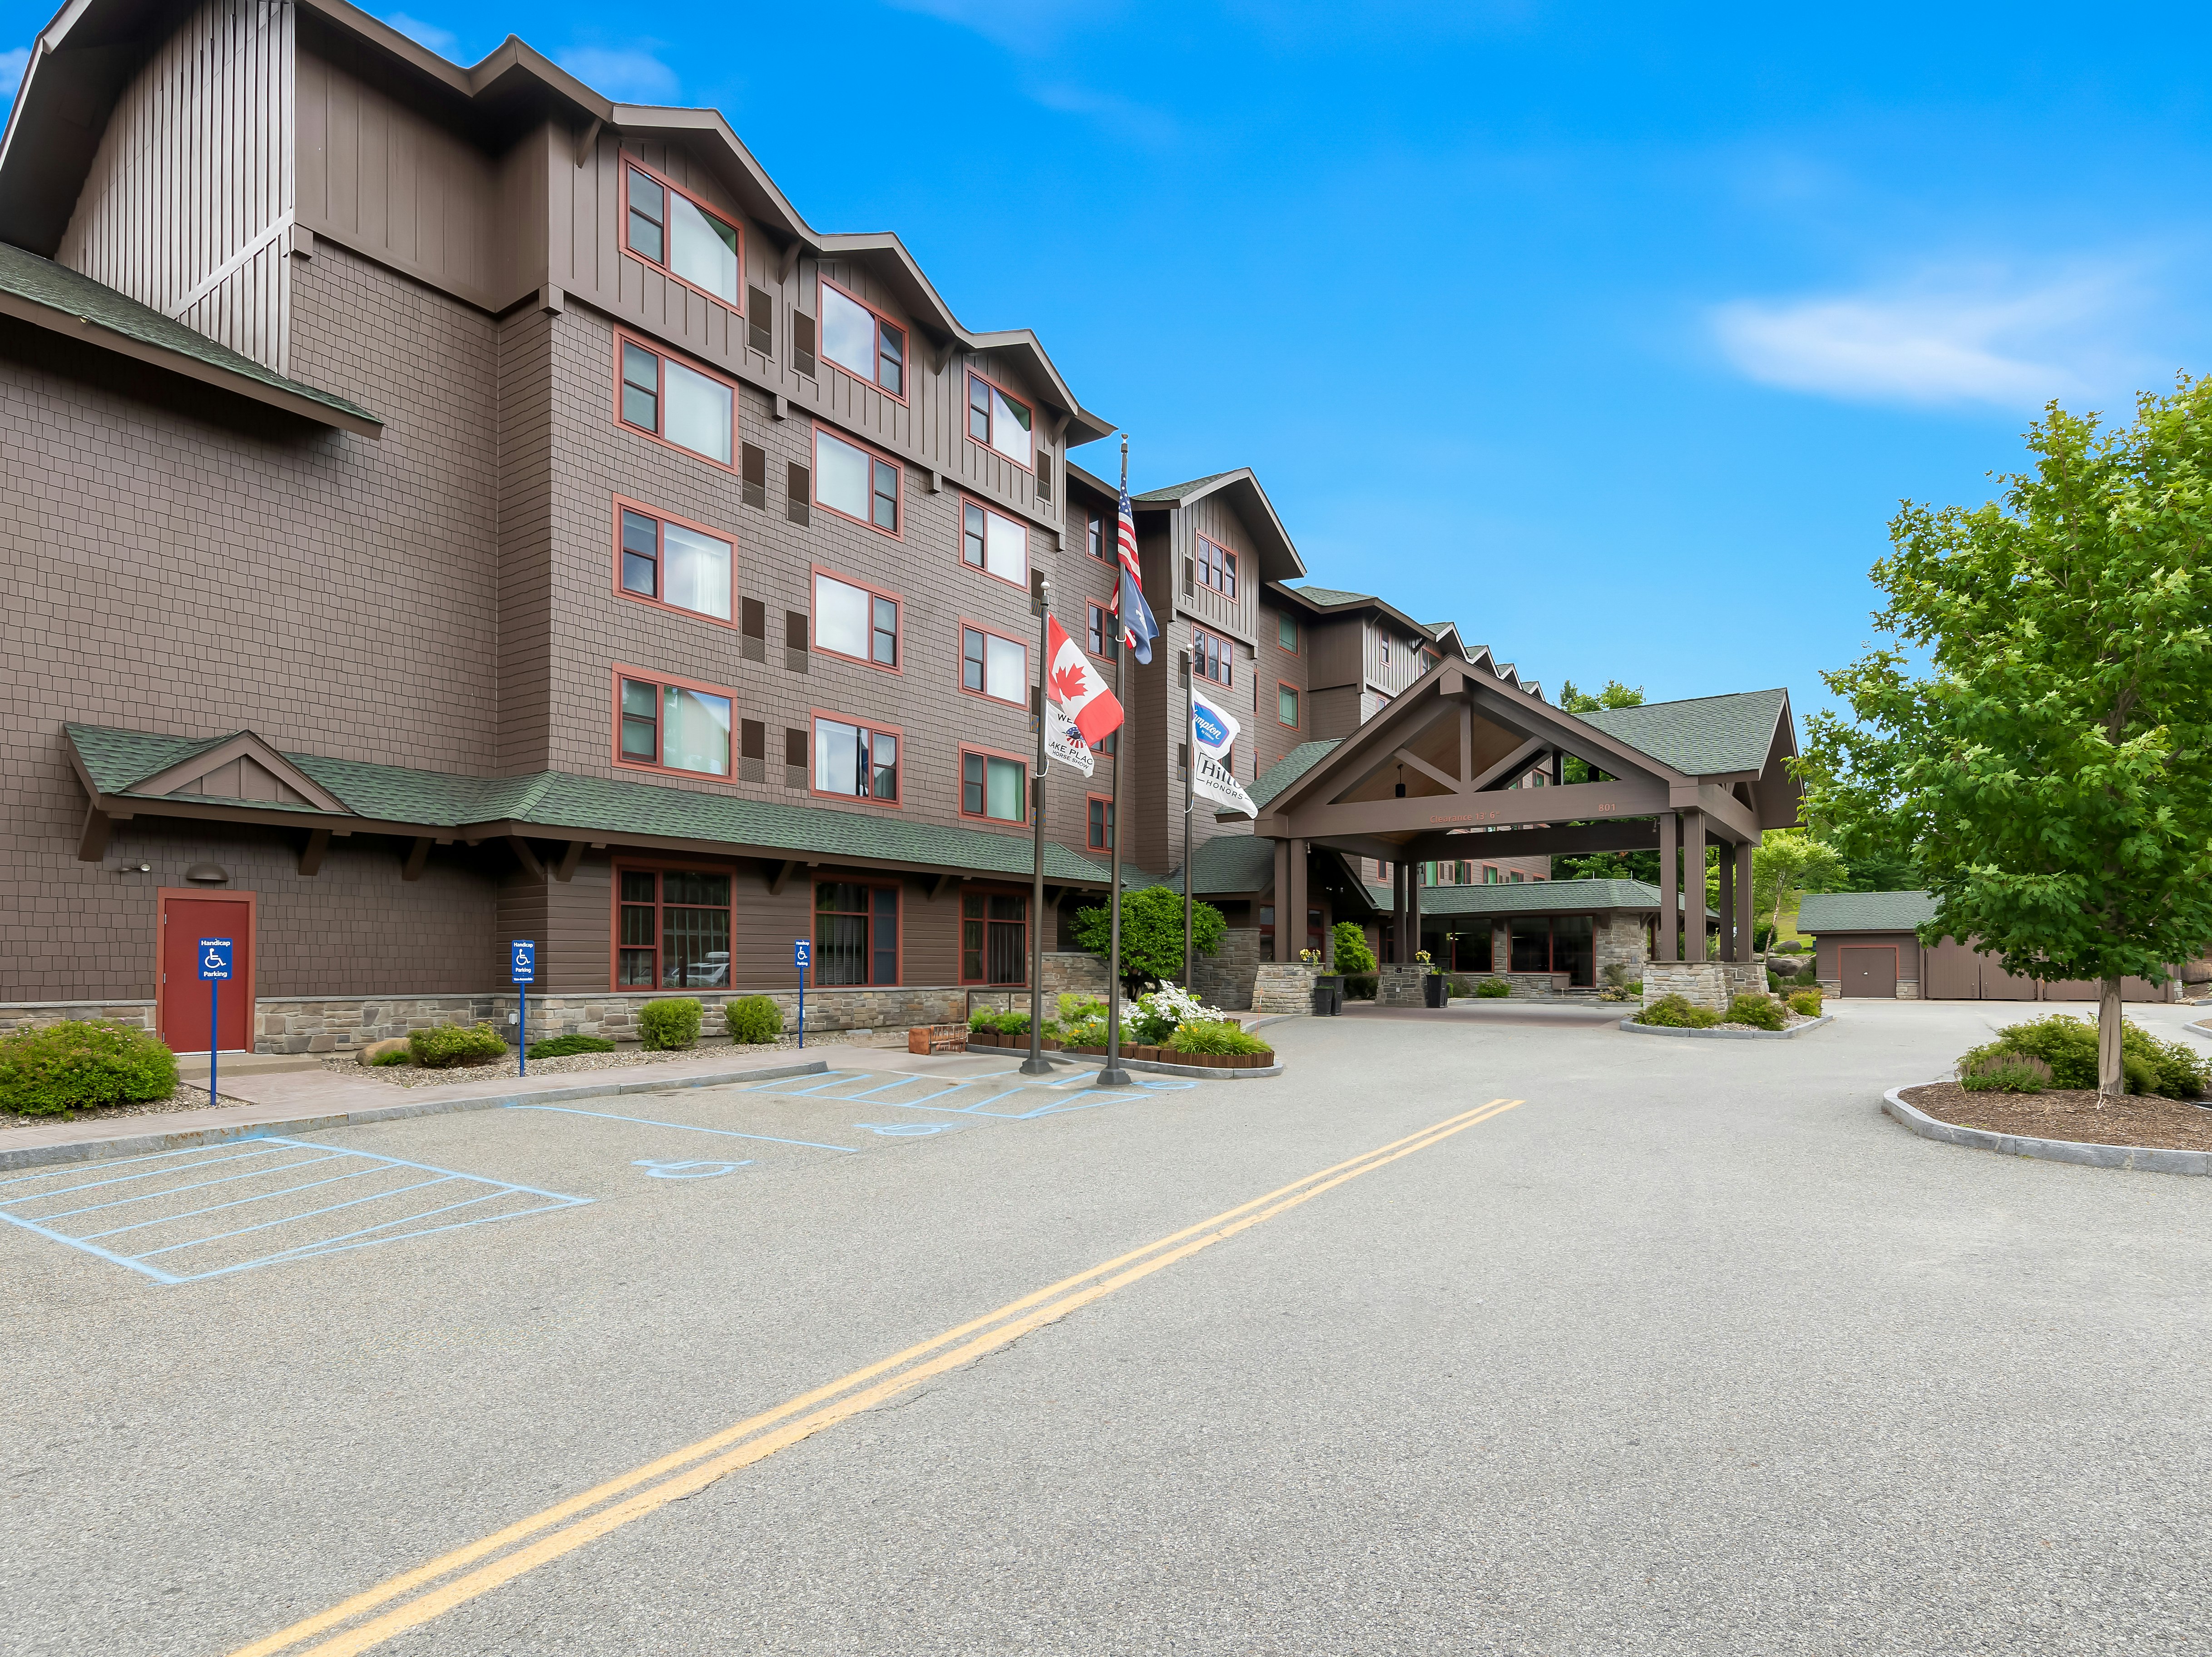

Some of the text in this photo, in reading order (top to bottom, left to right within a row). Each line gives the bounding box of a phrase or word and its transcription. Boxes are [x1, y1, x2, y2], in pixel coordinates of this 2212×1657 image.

[1204, 732, 1214, 740] Hilton
[1052, 750, 1089, 769] HORSE SHOW
[1069, 749, 1093, 765] PLAC
[1201, 759, 1241, 789] Hilto
[1206, 779, 1243, 799] HONORS
[1598, 804, 1615, 812] 801
[1430, 814, 1472, 824] Clearance
[1476, 812, 1487, 820] 13'
